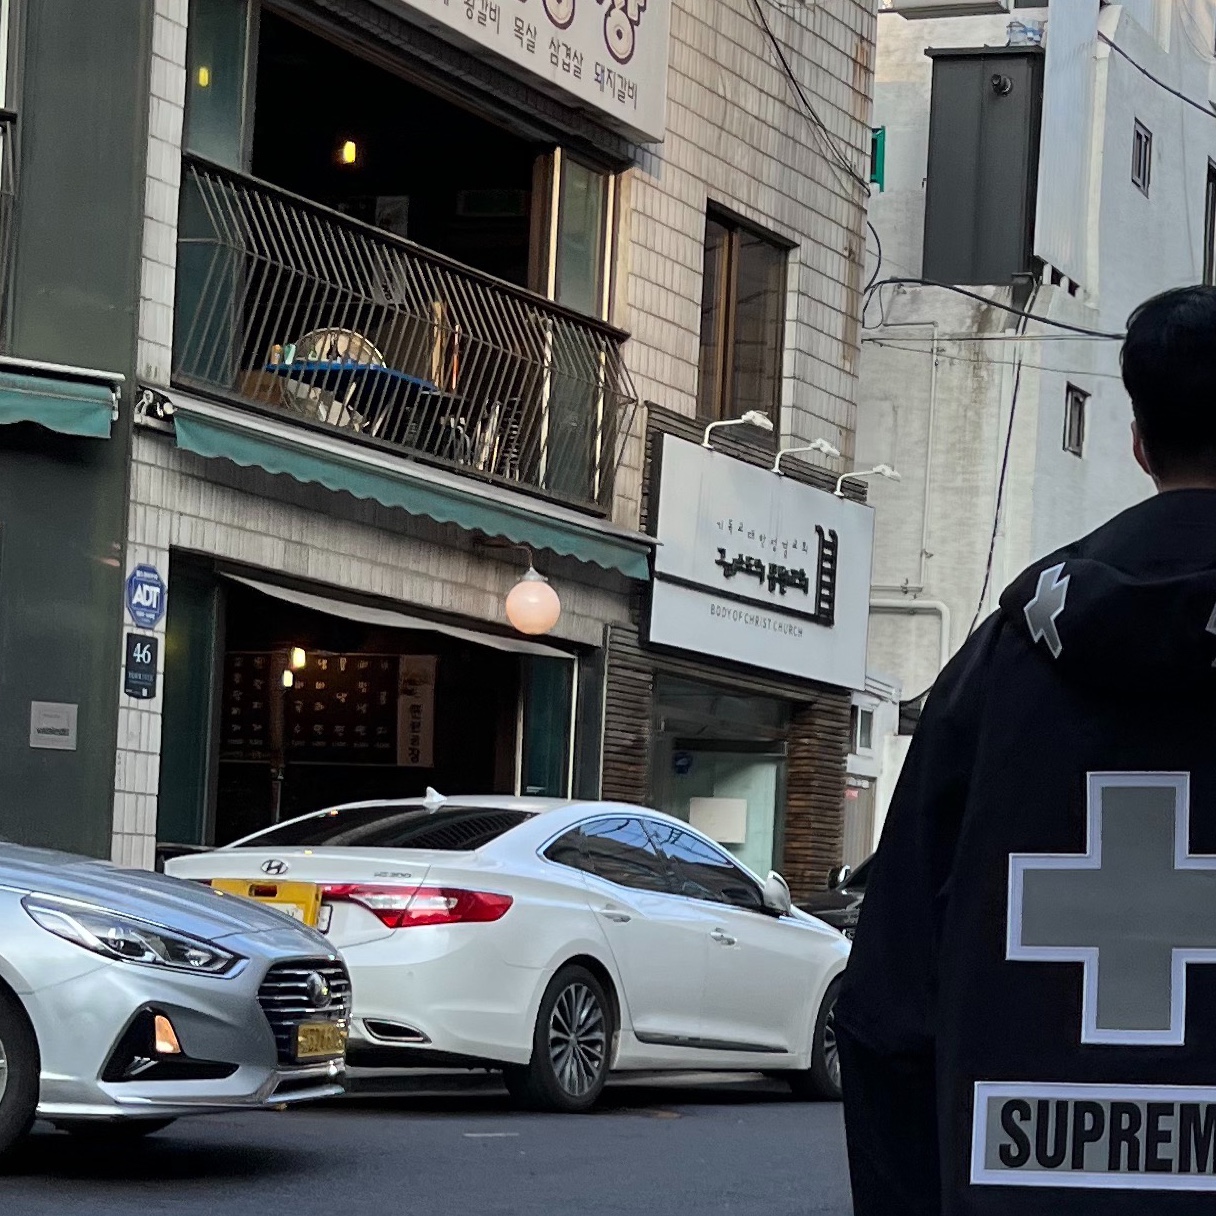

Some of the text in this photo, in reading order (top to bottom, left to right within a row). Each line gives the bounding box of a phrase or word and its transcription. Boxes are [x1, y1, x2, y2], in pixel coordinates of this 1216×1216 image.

[514, 16, 538, 54] 목살
[549, 36, 584, 80] 삼겹살
[594, 61, 638, 110] 돼지갈비
[132, 583, 160, 609] ADT
[710, 603, 803, 638] BODY OF CHRIST CHURCH
[133, 642, 152, 664] 46
